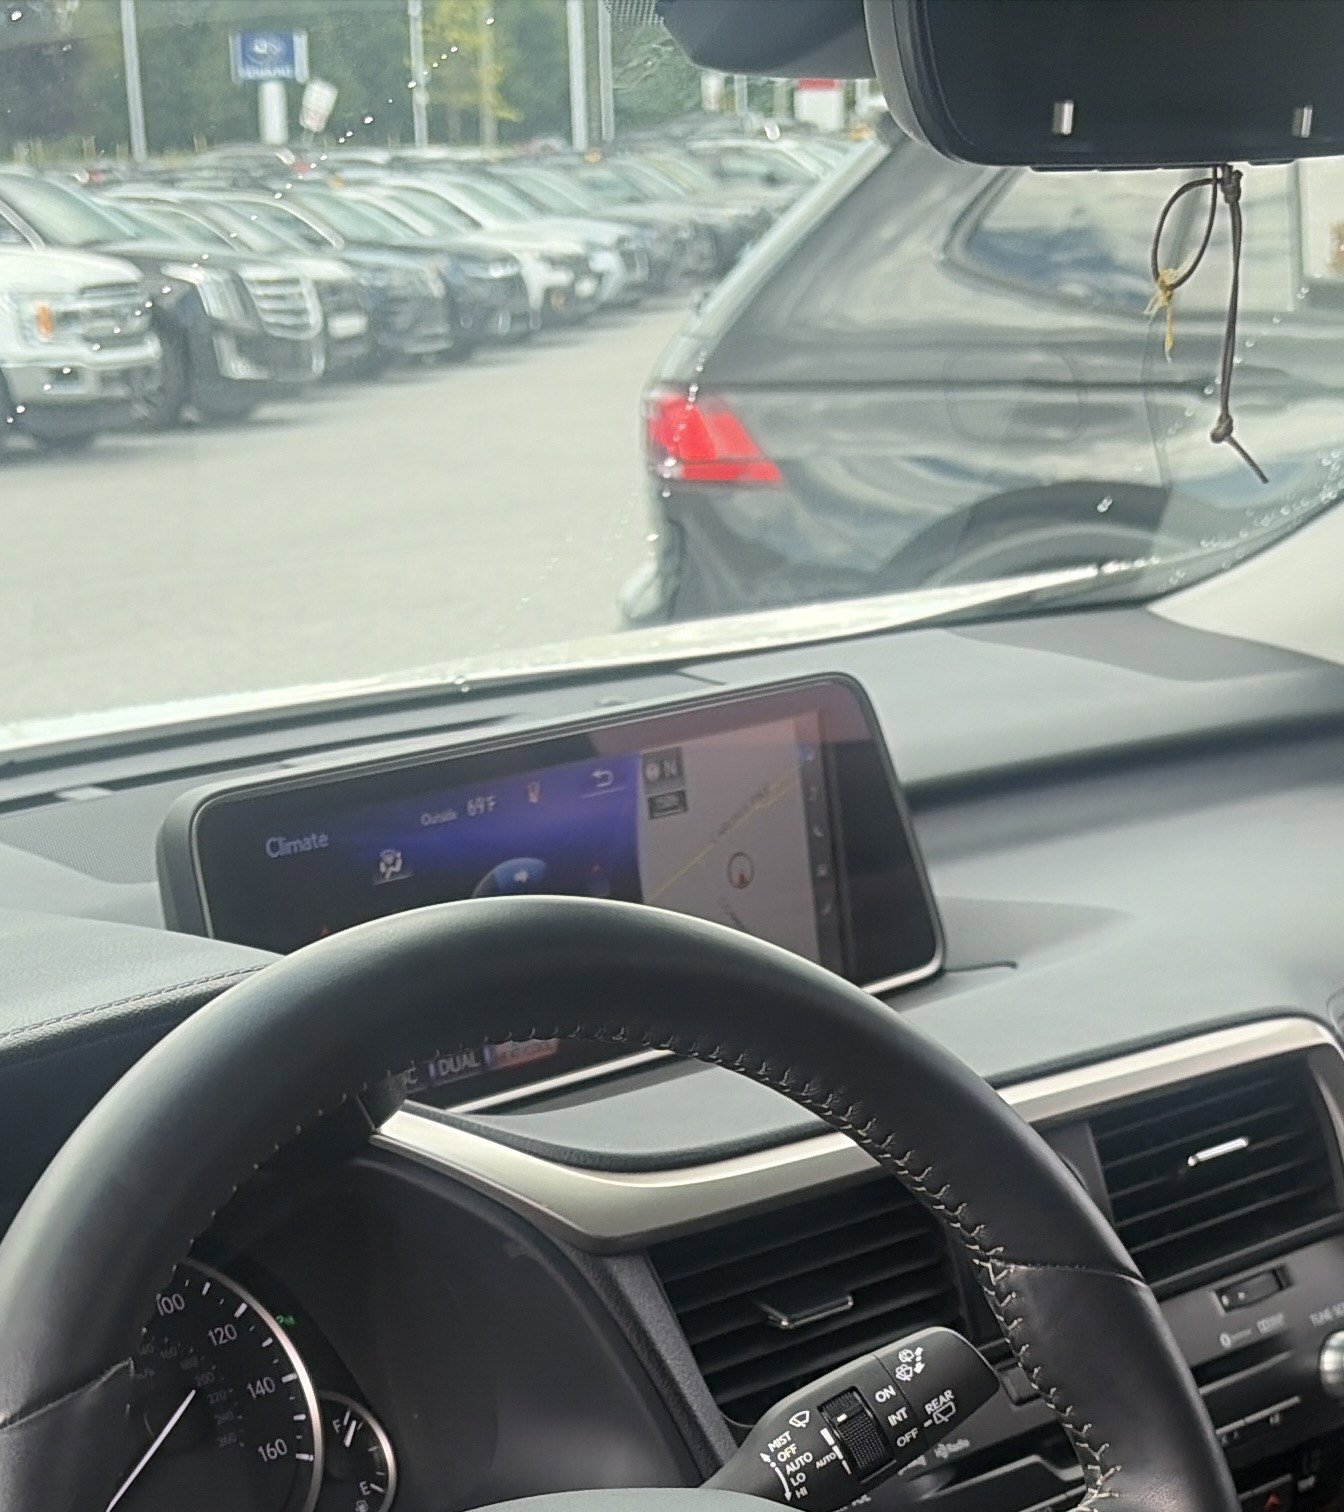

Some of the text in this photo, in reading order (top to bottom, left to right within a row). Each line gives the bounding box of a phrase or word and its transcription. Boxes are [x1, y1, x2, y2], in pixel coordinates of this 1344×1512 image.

[265, 832, 330, 859] Climate
[438, 1050, 481, 1076] DUAL
[156, 1293, 185, 1317] 100
[208, 1323, 238, 1347] 120
[246, 1376, 276, 1400] 140
[874, 1384, 897, 1403] ON
[923, 1389, 955, 1416] REAR
[332, 1418, 342, 1434] F
[886, 1406, 909, 1428] INT
[767, 1430, 793, 1452] MIST
[896, 1427, 920, 1448] OFF
[257, 1438, 288, 1463] 160
[777, 1443, 798, 1463] OFF
[815, 1452, 838, 1470] AUTO
[785, 1451, 814, 1476] AUTO
[359, 1480, 372, 1497] E
[789, 1472, 807, 1487] LO
[794, 1486, 809, 1500] HI
